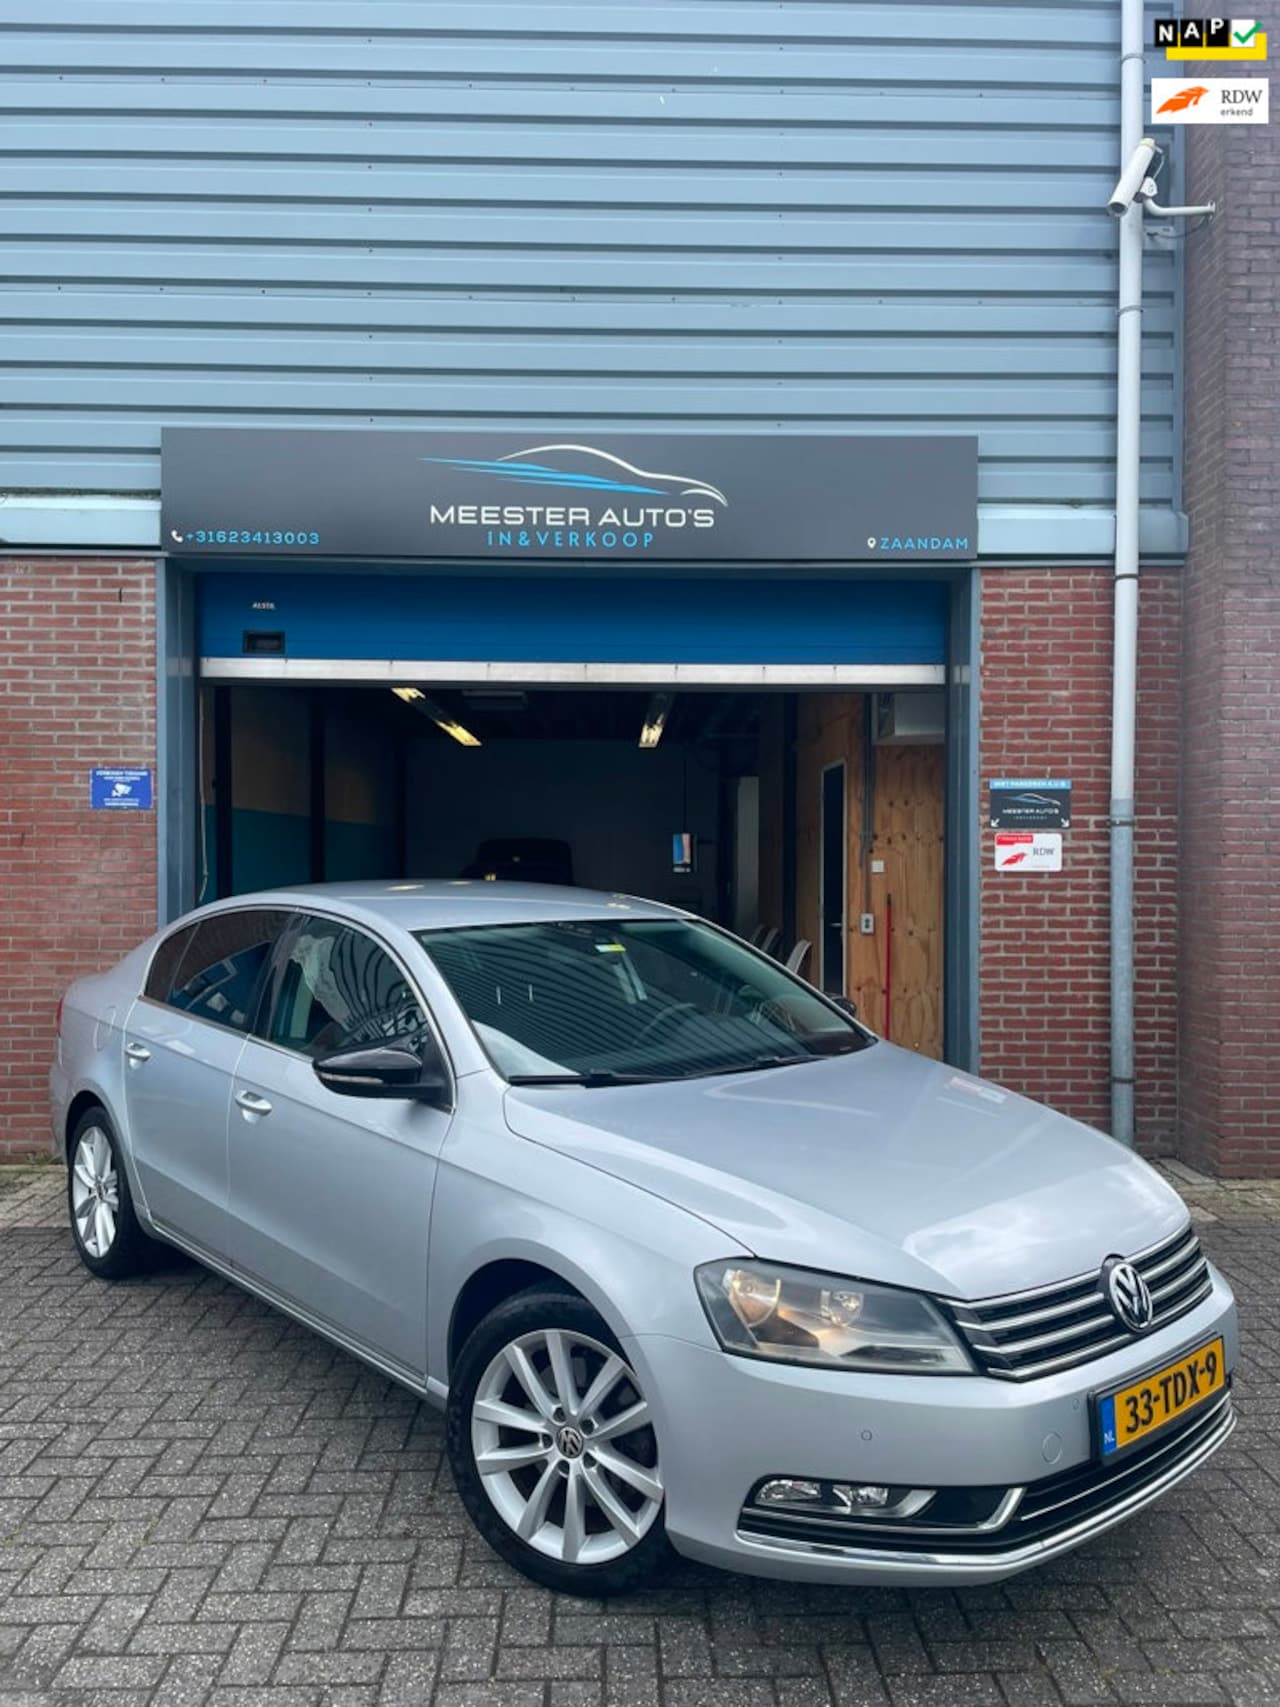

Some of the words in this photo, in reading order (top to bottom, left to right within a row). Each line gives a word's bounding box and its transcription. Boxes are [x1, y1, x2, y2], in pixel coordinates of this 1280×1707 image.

[430, 505, 589, 526] MEESTER
[598, 508, 714, 528] AUTO'S
[186, 530, 320, 545] +31623413003
[487, 531, 654, 548] IN&VERKOOP
[880, 537, 968, 549] ZAANDAM
[1032, 847, 1055, 856] RDW
[1125, 1350, 1217, 1433] 33-TDX-9
[1104, 1430, 1115, 1445] NL
